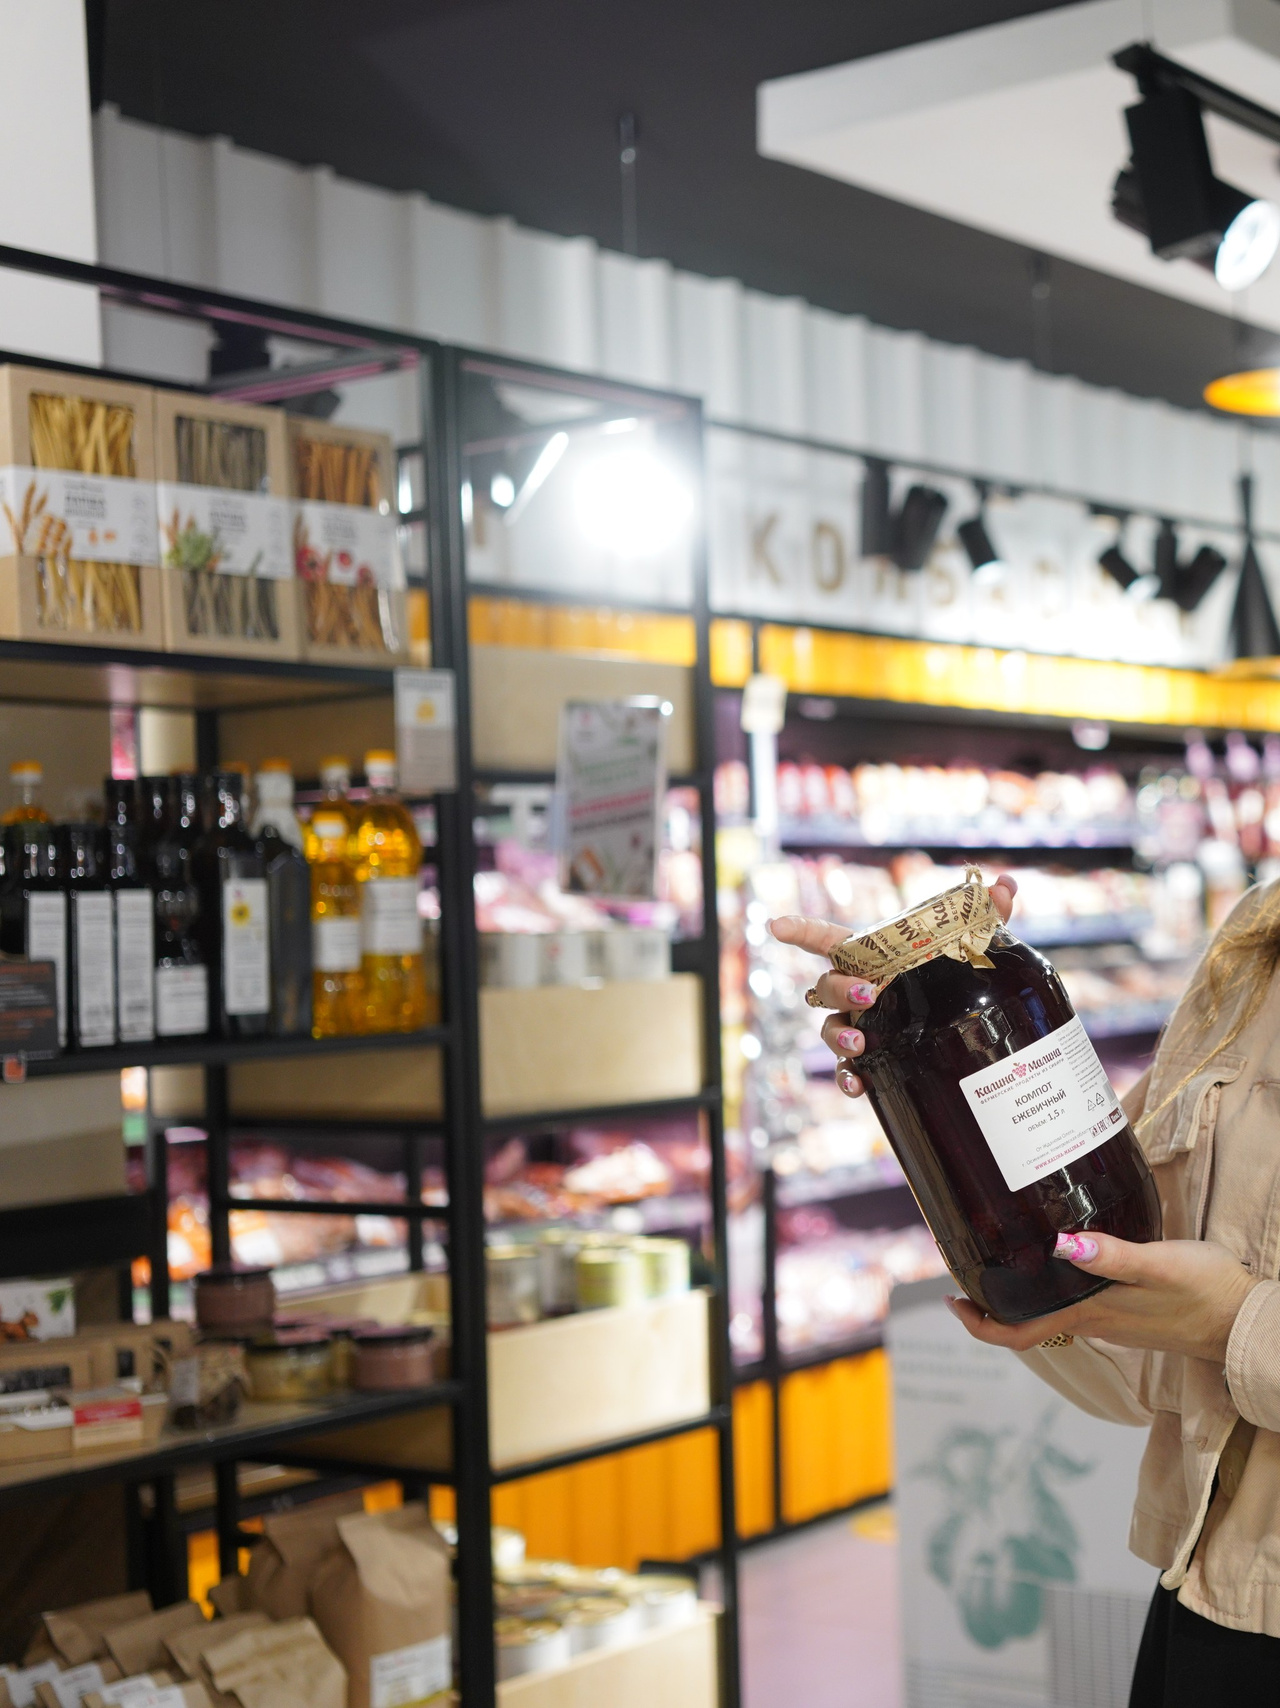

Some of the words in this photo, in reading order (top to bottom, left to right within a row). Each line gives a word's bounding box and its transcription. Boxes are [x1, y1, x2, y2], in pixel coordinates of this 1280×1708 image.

[974, 1074, 1016, 1099] Калина
[1027, 1047, 1062, 1073] Малина
[1011, 1089, 1067, 1125] ЕЖЕВИЧНЫЙ
[1014, 1081, 1053, 1107] КОМПОТ
[1049, 1109, 1061, 1123] 1,5
